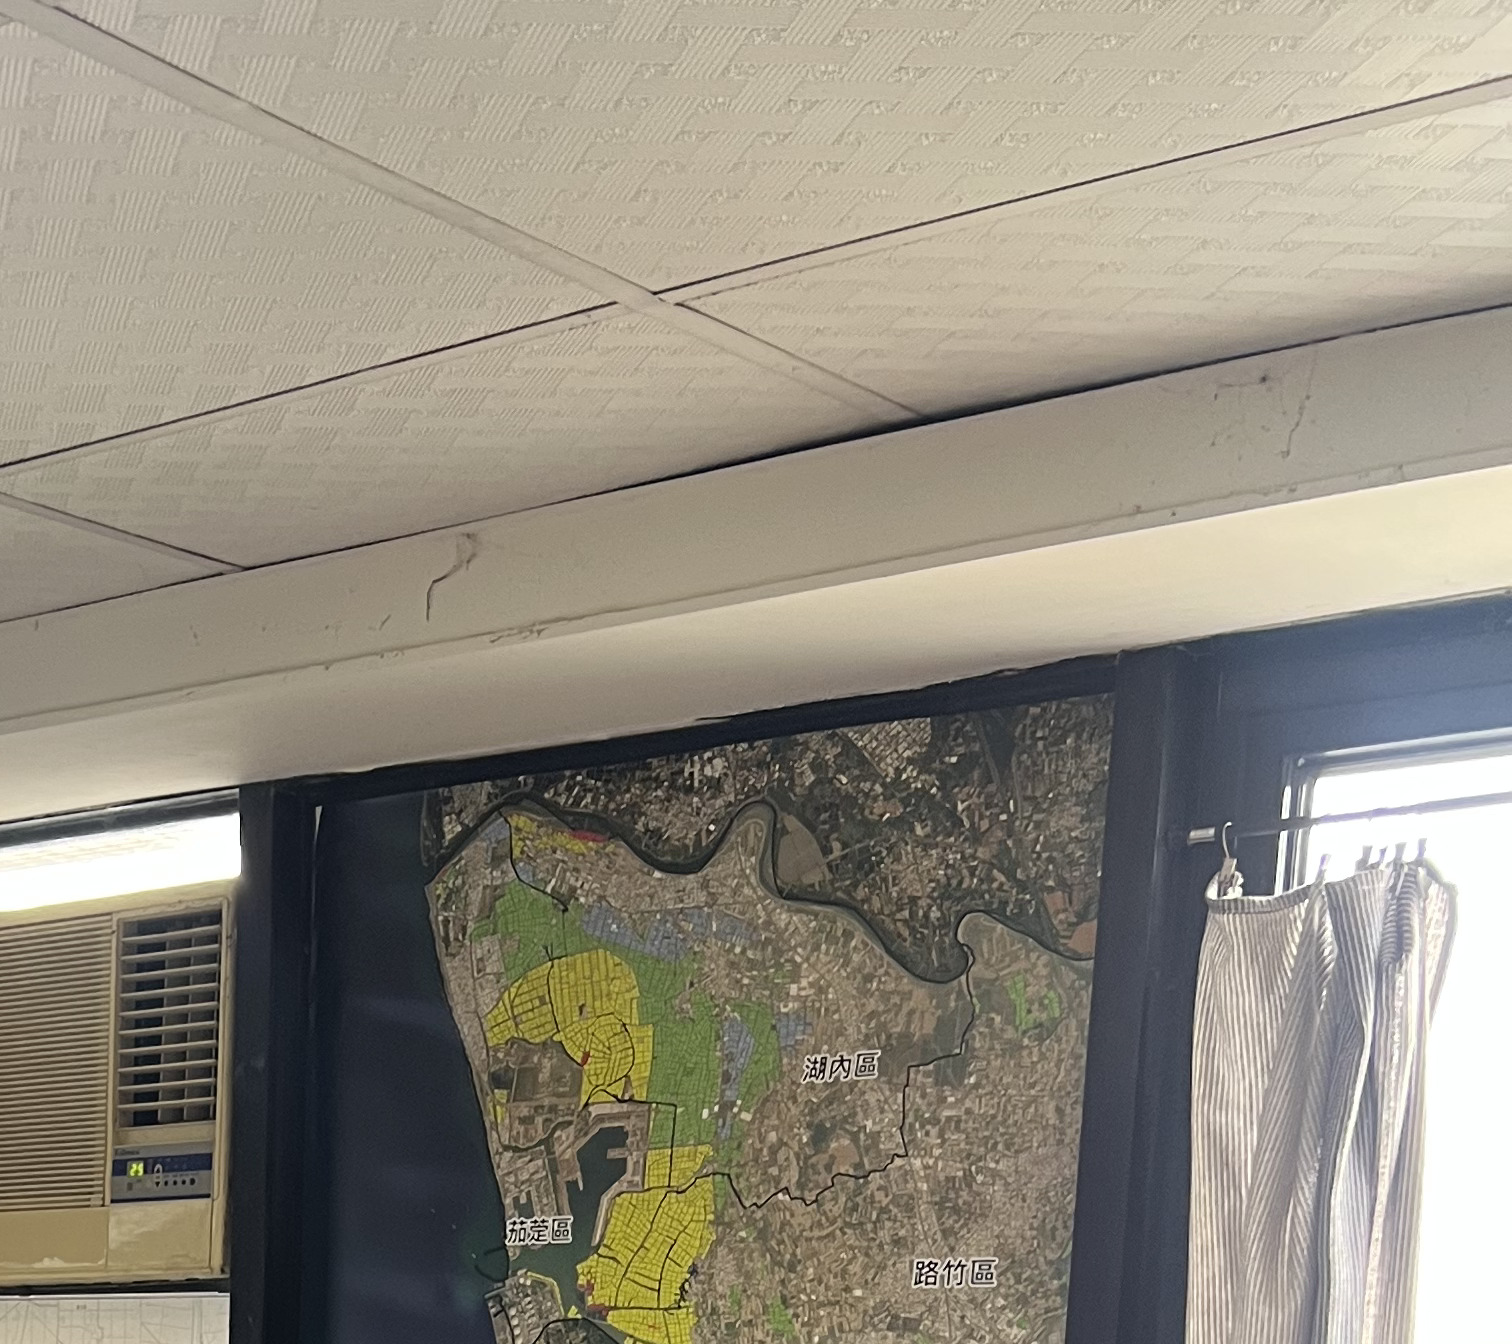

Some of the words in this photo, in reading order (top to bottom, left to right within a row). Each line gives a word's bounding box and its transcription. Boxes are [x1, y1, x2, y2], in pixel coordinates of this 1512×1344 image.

[803, 1051, 880, 1083] 湖內區
[506, 1217, 573, 1245] 茄萣區
[913, 1258, 997, 1288] 路竹區
